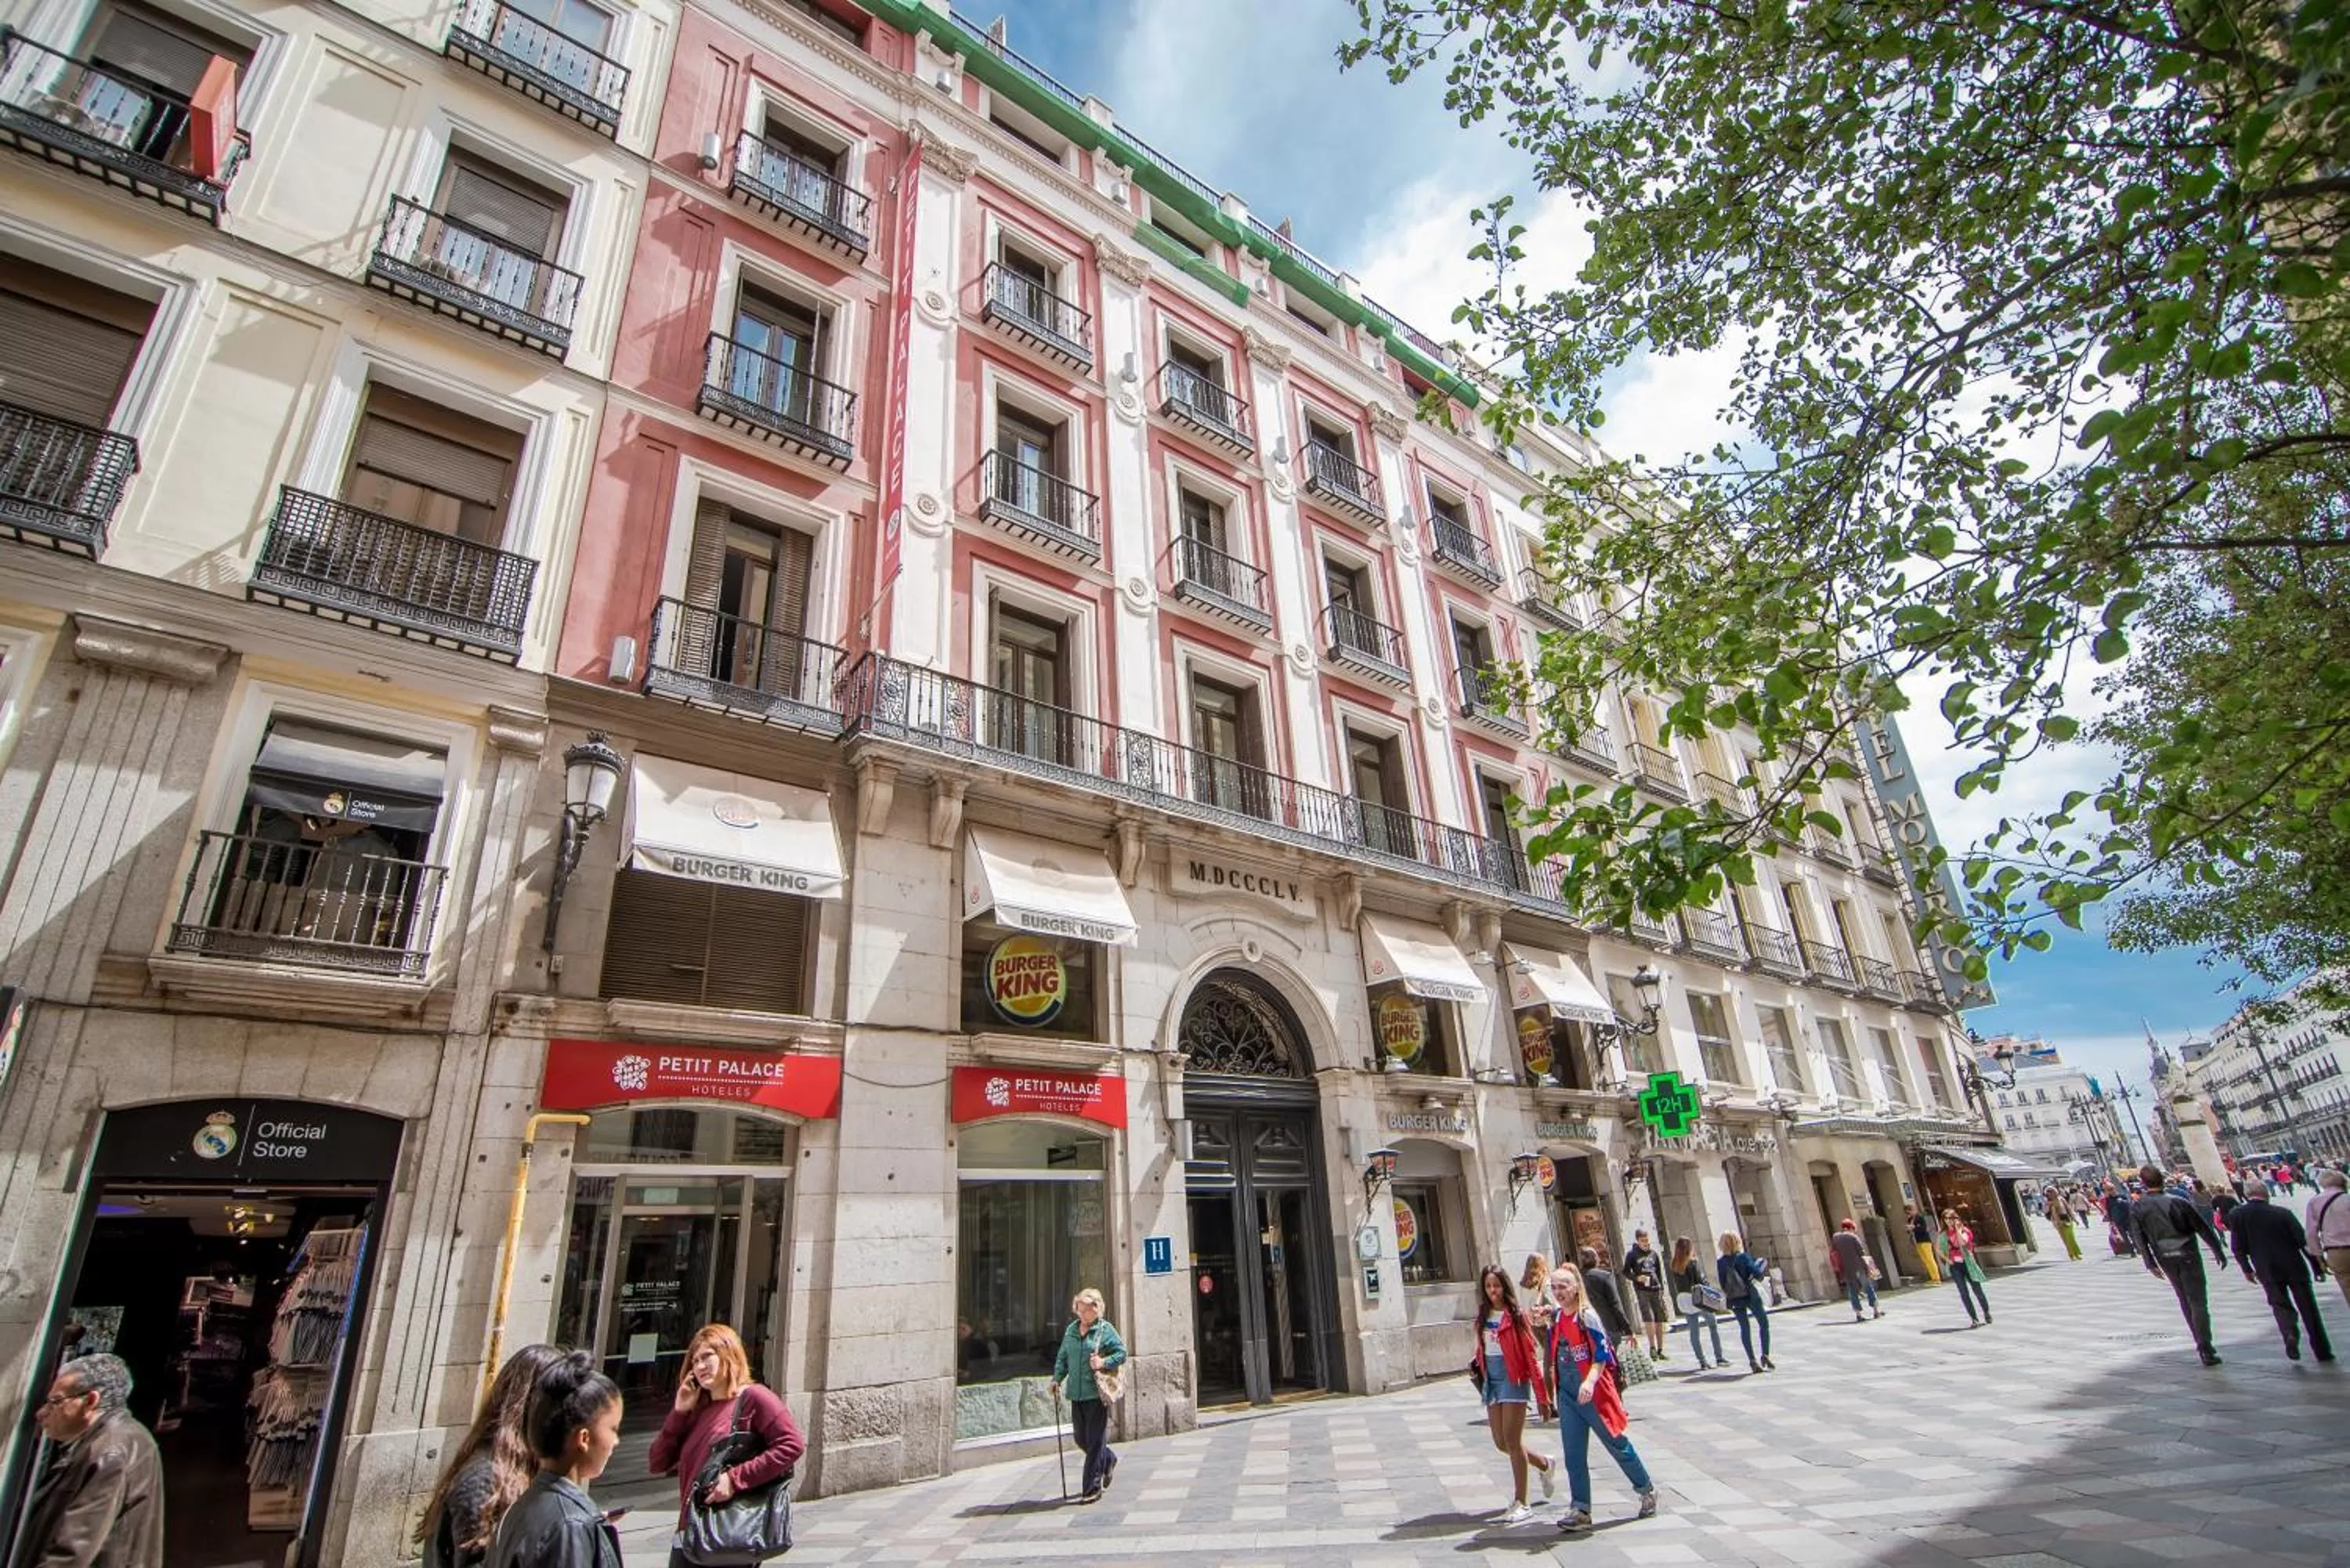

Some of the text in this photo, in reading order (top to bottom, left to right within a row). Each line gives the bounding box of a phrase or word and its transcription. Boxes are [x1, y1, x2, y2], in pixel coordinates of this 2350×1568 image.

[891, 168, 917, 493] PETIT PALACE
[350, 807, 377, 818] Store
[352, 800, 385, 811] Official
[671, 855, 808, 891] BURGER KING
[1885, 791, 1968, 974] MORO
[1021, 913, 1115, 941] BURGER KING
[994, 954, 1060, 1002] BURGER KING
[1381, 1008, 1420, 1044] BURGER KING
[1521, 1042, 1552, 1064] KING
[658, 1057, 785, 1078] PETIT PALACE
[692, 1085, 751, 1097] HOTELES
[1015, 1078, 1102, 1096] PETIT PALACE
[1039, 1102, 1081, 1112] HOTELES
[1655, 1097, 1683, 1114] 12H
[257, 1122, 327, 1140] Official
[1388, 1113, 1467, 1131] BURGER KING
[253, 1141, 308, 1158] Store
[1152, 1241, 1165, 1261] H
